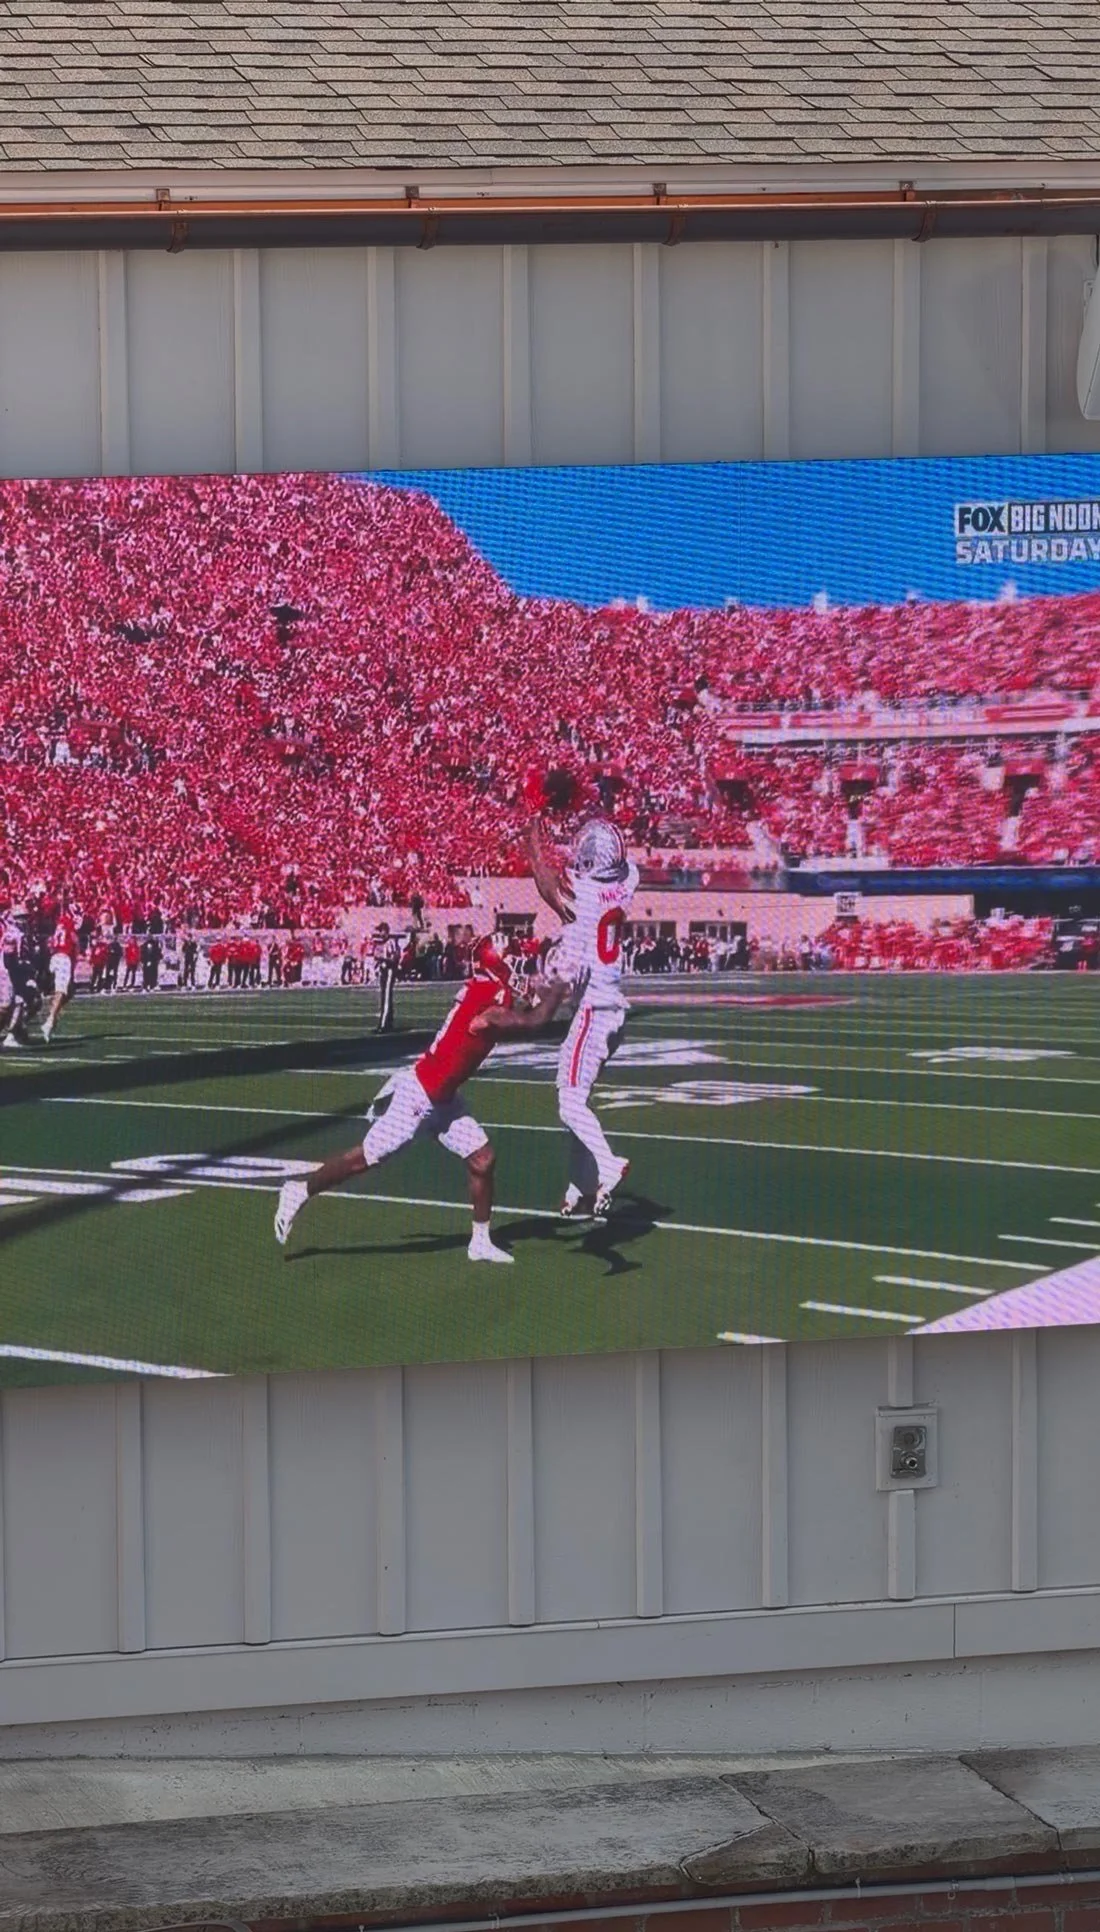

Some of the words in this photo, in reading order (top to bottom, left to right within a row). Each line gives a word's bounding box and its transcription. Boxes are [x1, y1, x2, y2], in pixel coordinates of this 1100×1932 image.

[957, 506, 1006, 534] FOX
[1010, 504, 1046, 532] BIG
[955, 537, 1100, 565] SATURDAY
[597, 906, 627, 965] 0
